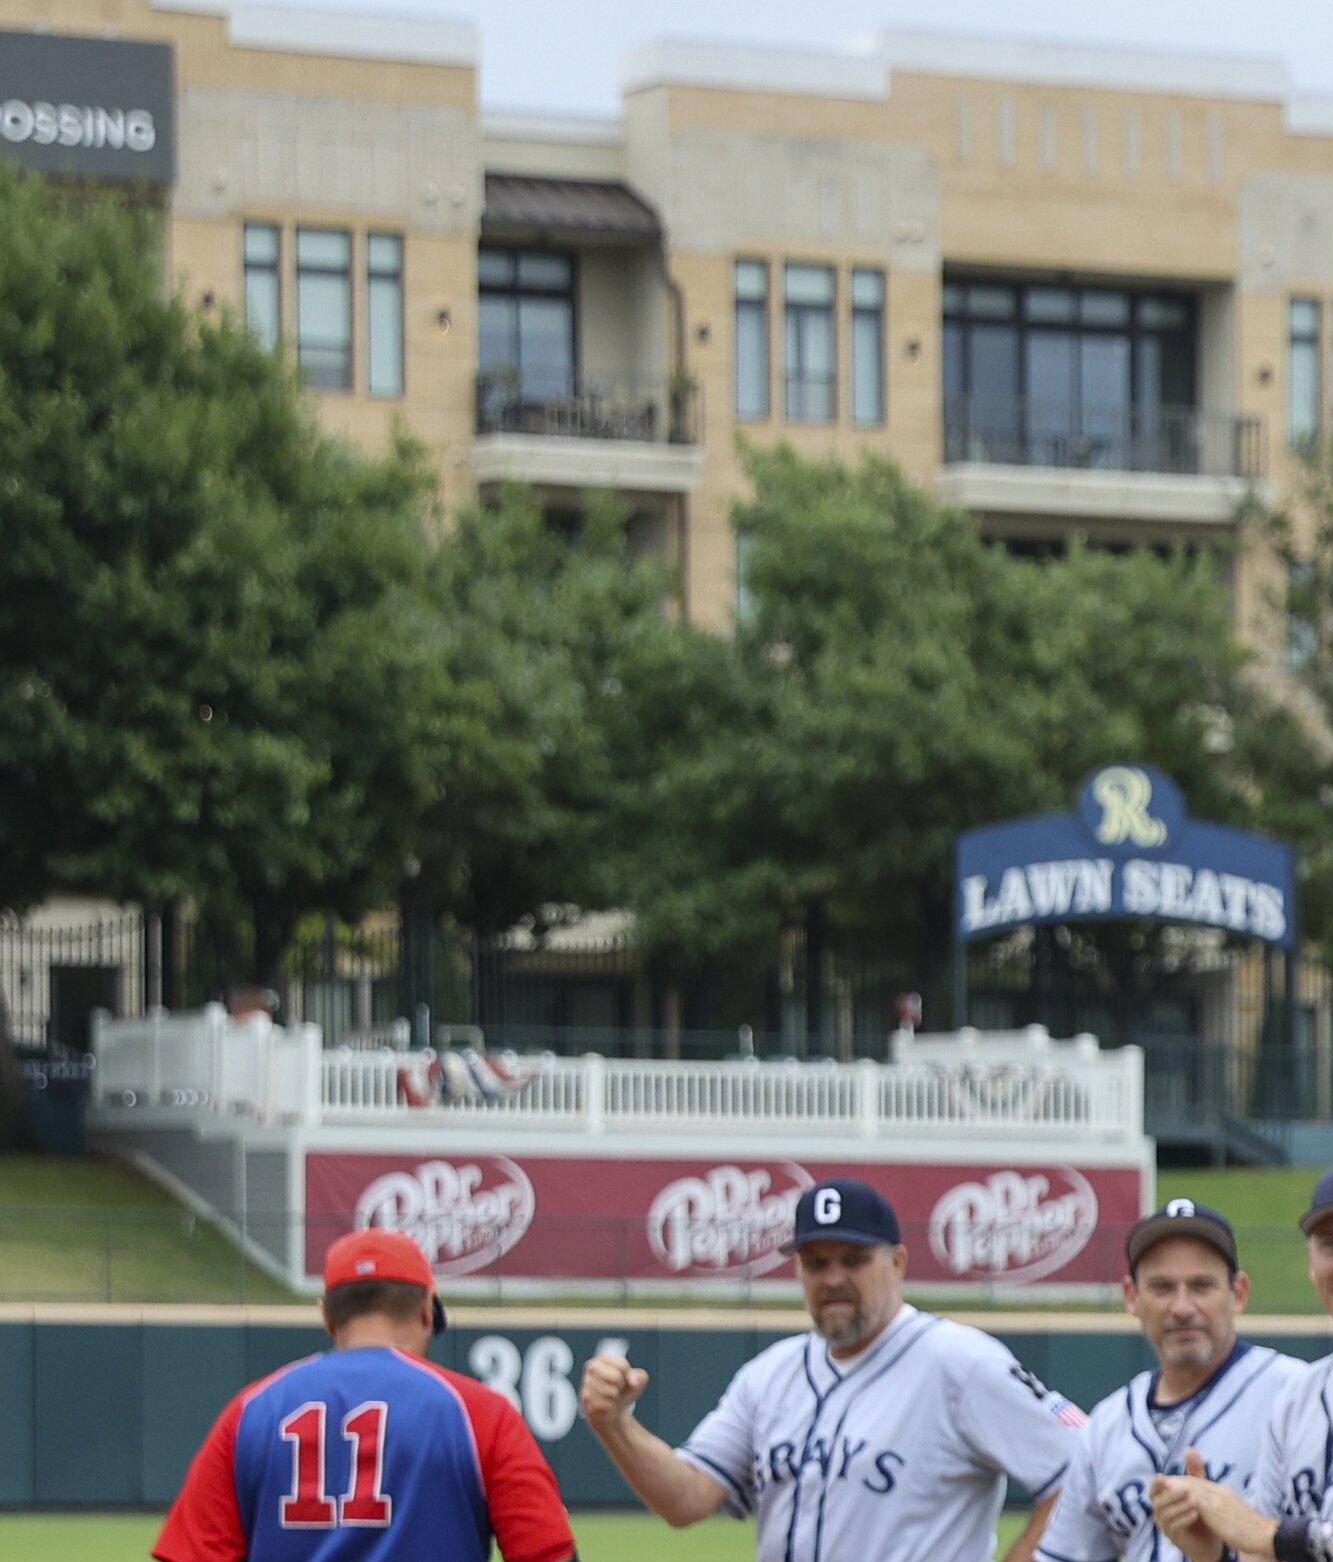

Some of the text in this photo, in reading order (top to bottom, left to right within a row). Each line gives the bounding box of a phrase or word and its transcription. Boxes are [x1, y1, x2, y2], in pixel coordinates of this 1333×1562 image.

[1093, 766, 1167, 848] R
[961, 857, 1286, 941] LAWN SEATS
[815, 1188, 842, 1225] G
[468, 1335, 637, 1441] 36
[279, 1400, 392, 1529] 11
